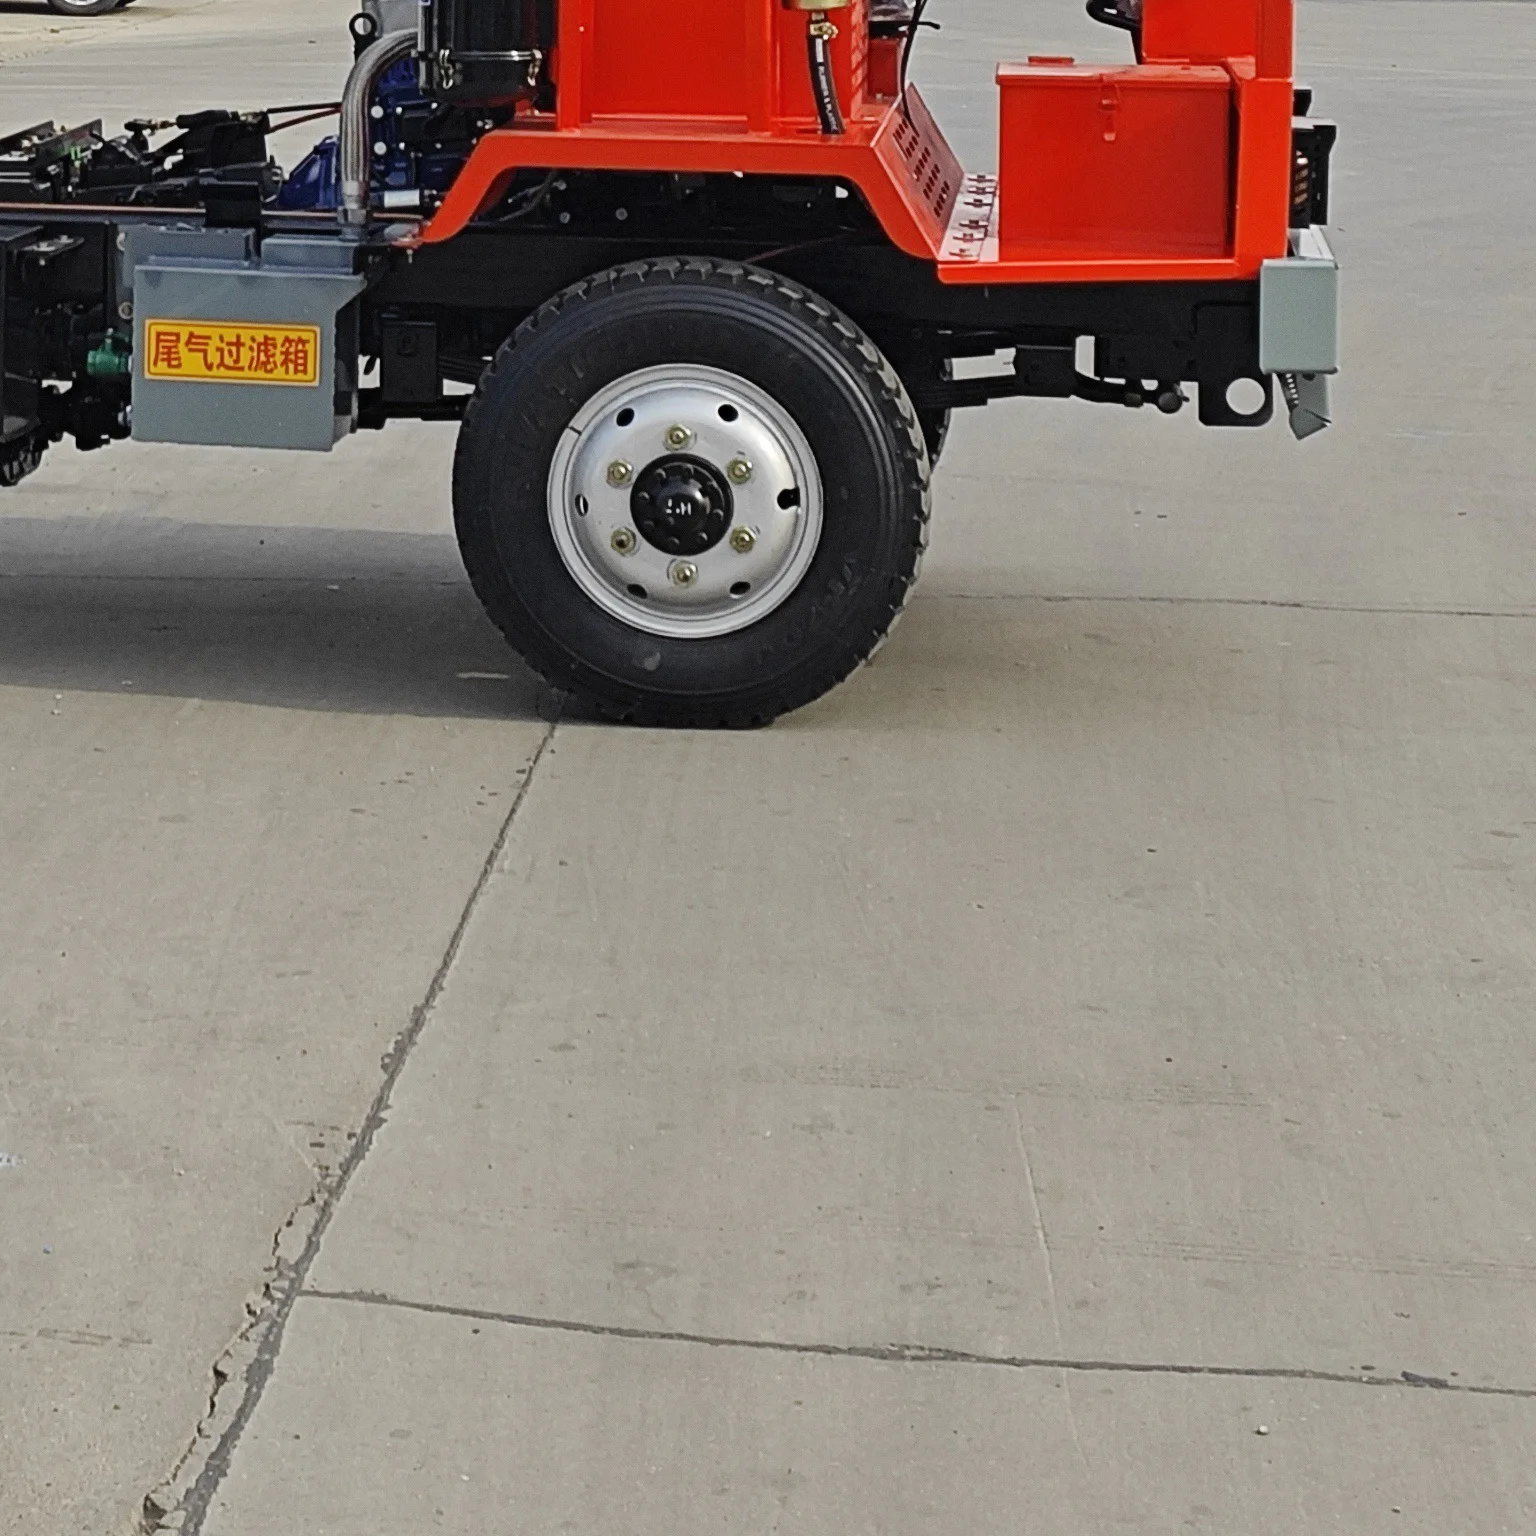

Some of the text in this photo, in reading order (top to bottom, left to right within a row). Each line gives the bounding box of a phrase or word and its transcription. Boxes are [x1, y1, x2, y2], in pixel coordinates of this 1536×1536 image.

[152, 331, 310, 376] 尾气过滤箱
